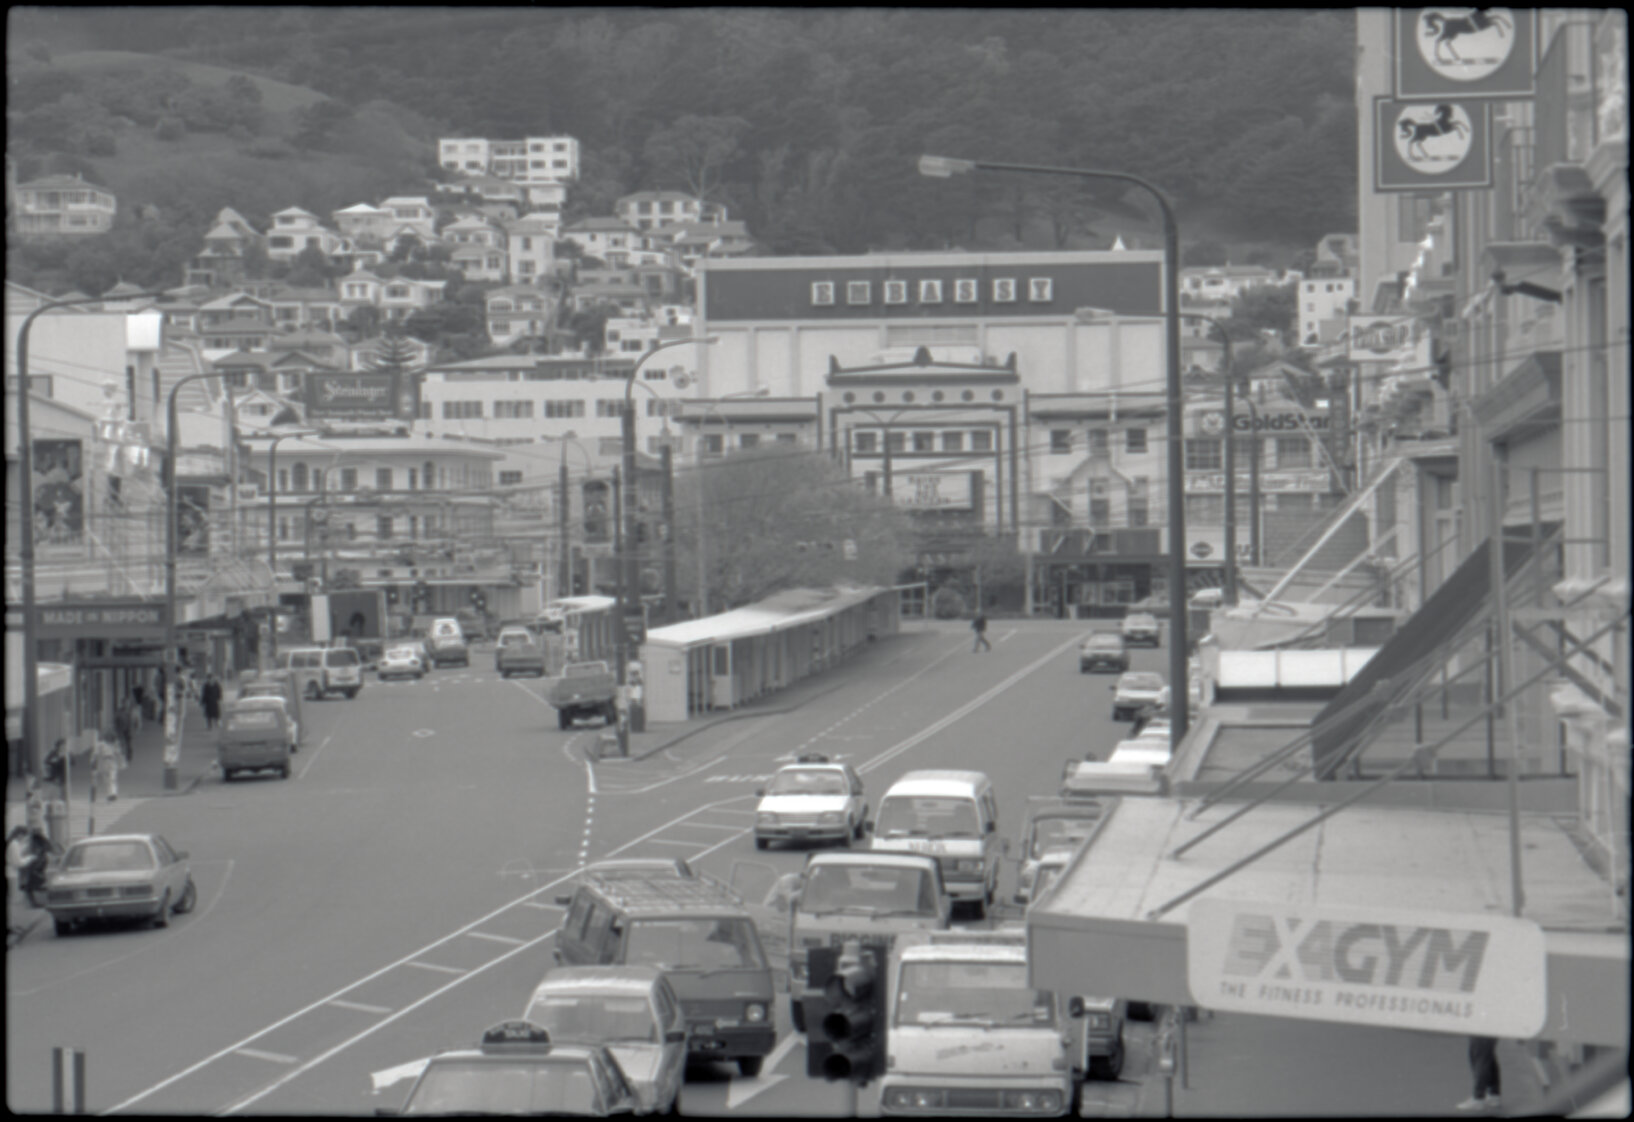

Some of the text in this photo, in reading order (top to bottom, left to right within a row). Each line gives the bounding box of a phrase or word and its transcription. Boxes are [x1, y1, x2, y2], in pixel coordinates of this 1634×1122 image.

[812, 278, 1051, 304] EMBASSY
[323, 379, 387, 401] Steinlager
[1231, 413, 1330, 431] GoldStar
[43, 611, 82, 624] MADE
[102, 611, 158, 624] NIPPON
[1222, 914, 1489, 991] EX4GYM
[1220, 981, 1474, 1017] THE FITNESS PROFESSIONALS
